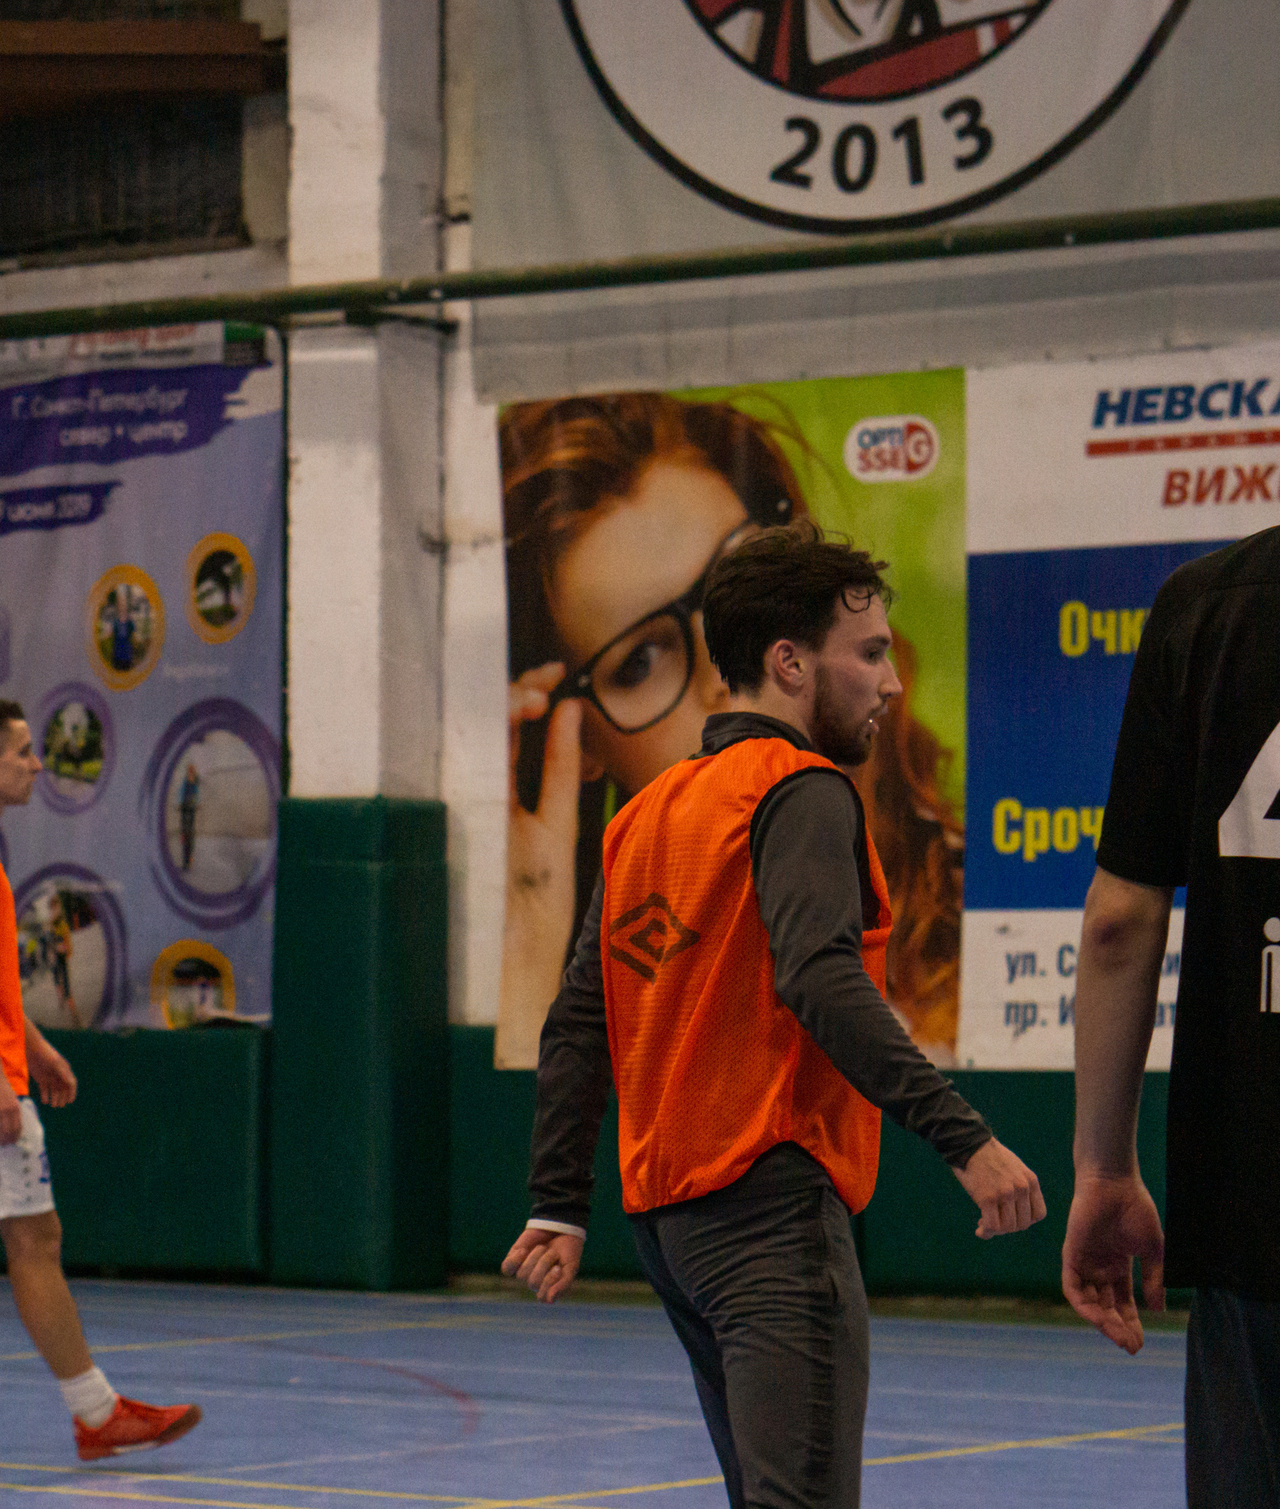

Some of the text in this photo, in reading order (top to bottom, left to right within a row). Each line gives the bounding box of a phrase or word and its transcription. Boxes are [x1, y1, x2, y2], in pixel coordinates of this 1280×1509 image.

[770, 97, 995, 193] 2013
[1162, 463, 1280, 507] ВИЖ
[1059, 600, 1150, 658] Очк
[991, 798, 1105, 863] Сроч
[1005, 950, 1047, 984] ул.
[1004, 1001, 1048, 1034] пр.
